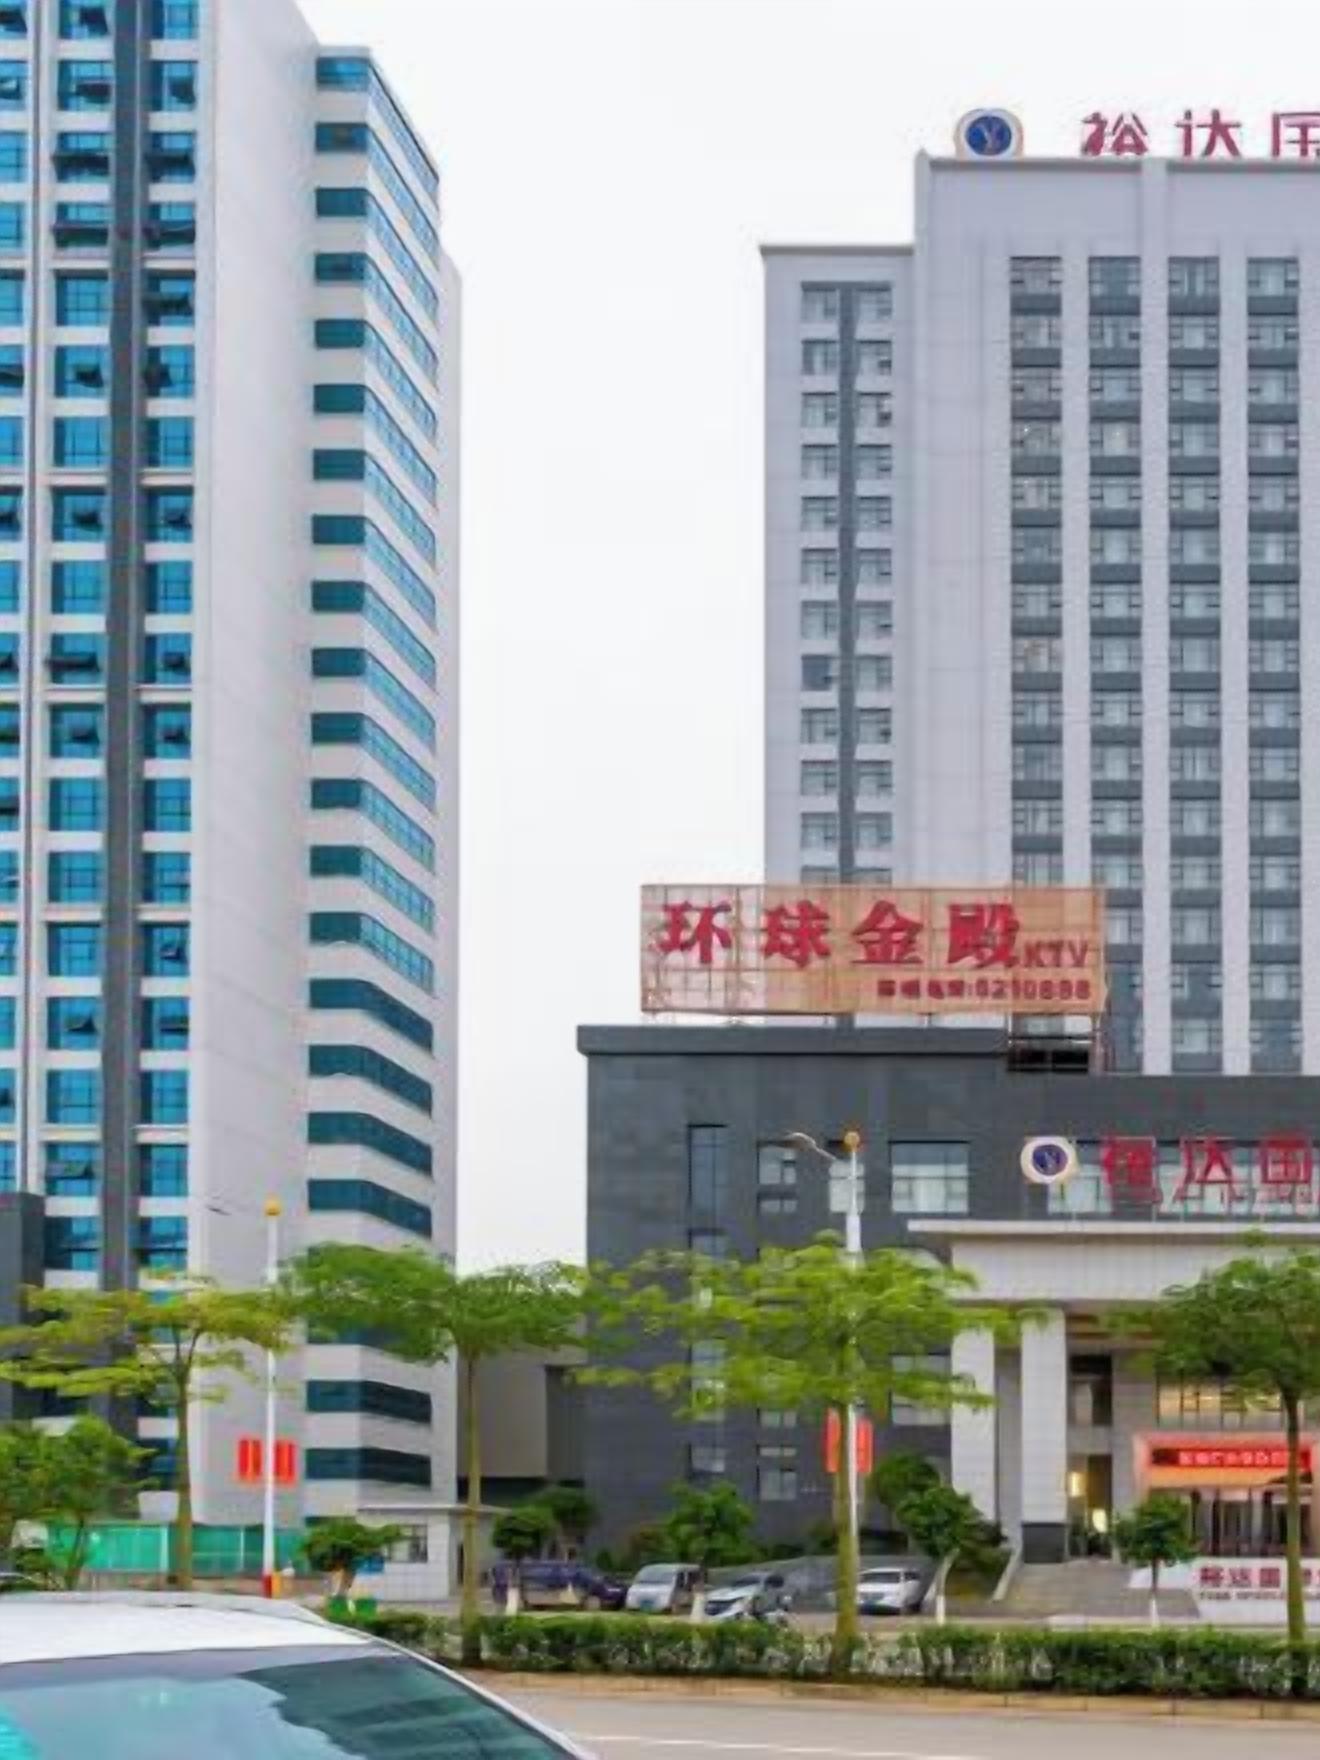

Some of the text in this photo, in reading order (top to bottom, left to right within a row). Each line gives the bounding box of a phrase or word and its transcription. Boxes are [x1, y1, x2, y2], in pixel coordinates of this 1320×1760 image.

[658, 901, 1089, 968] 环球金殿 KTV
